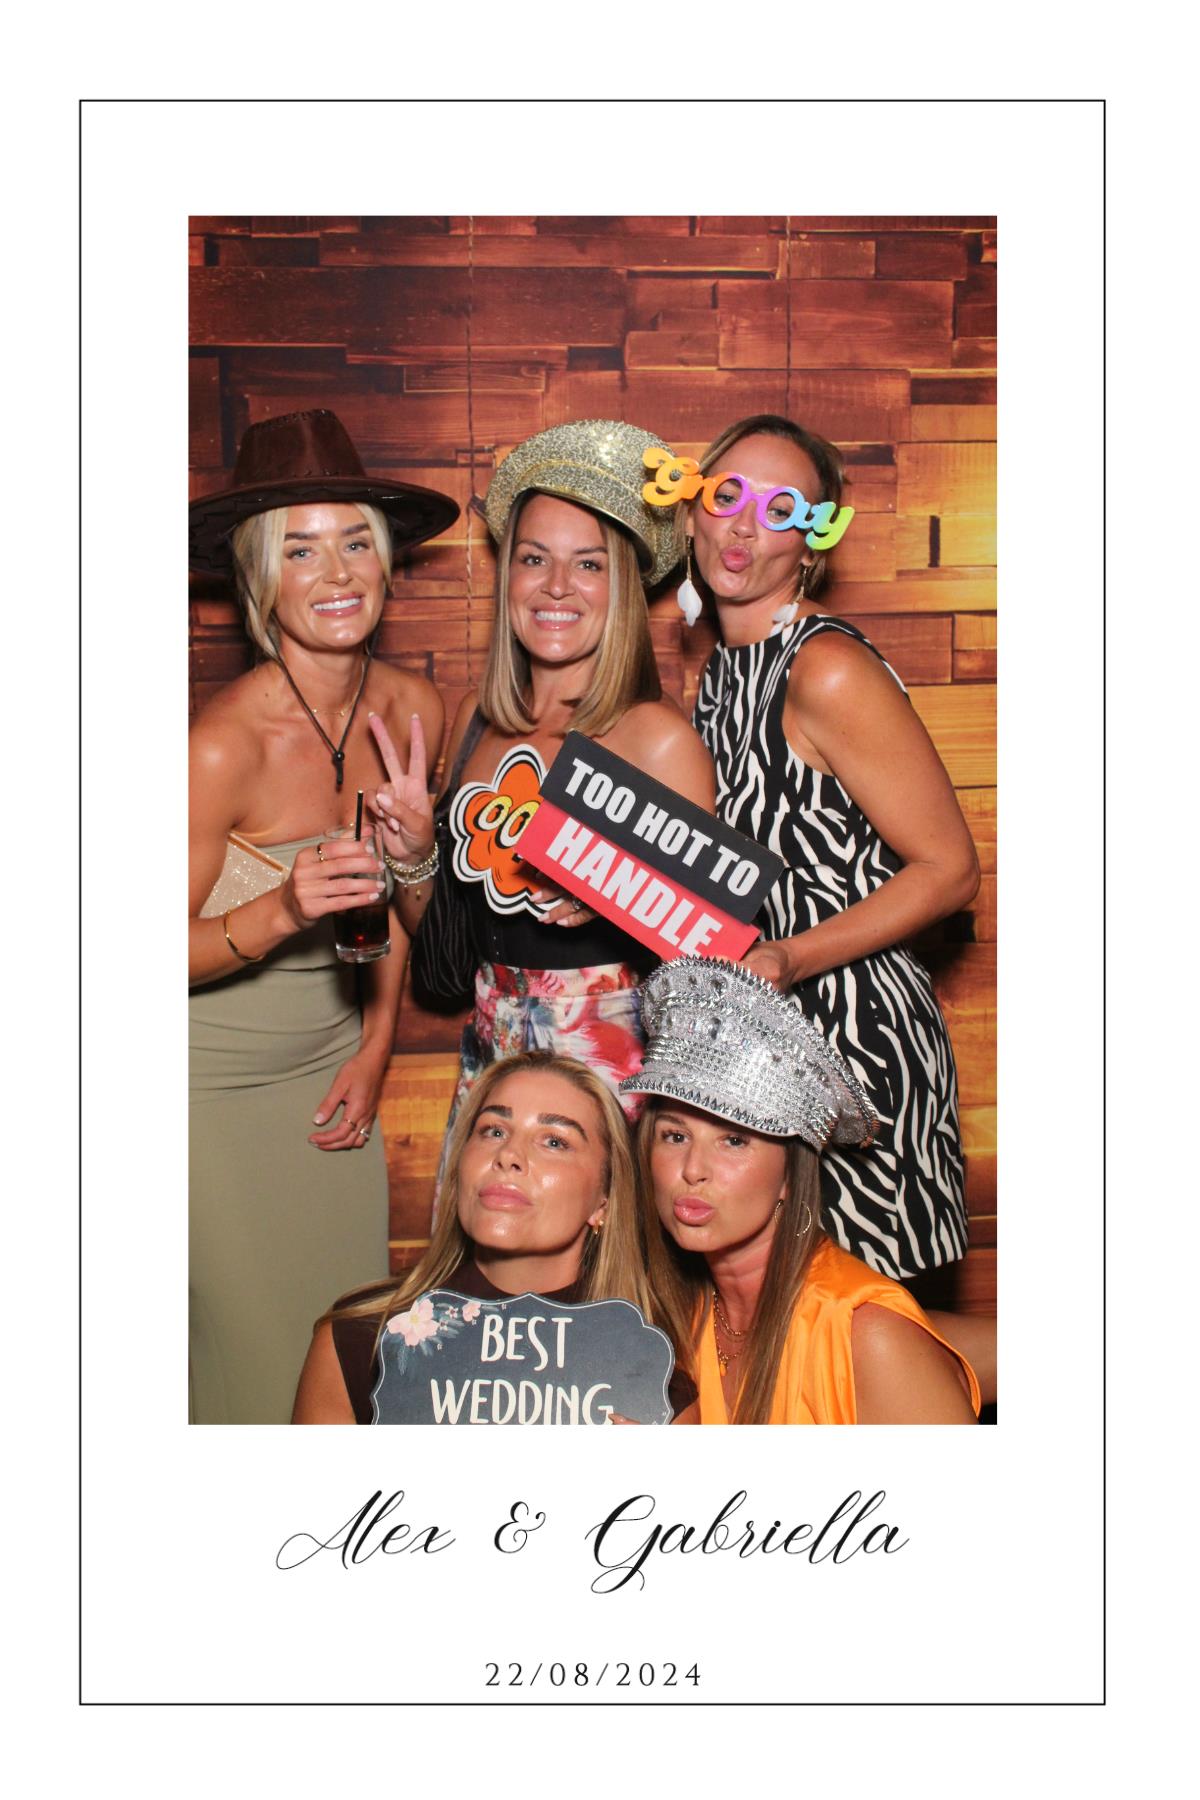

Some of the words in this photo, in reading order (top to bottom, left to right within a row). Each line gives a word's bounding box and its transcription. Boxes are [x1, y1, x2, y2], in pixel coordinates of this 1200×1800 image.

[564, 757, 636, 824] TOO
[632, 802, 713, 867] HOT
[708, 845, 761, 897] TO
[545, 817, 723, 957] HANDLE
[480, 1314, 573, 1372] BEST
[430, 1378, 615, 1425] WEDDING
